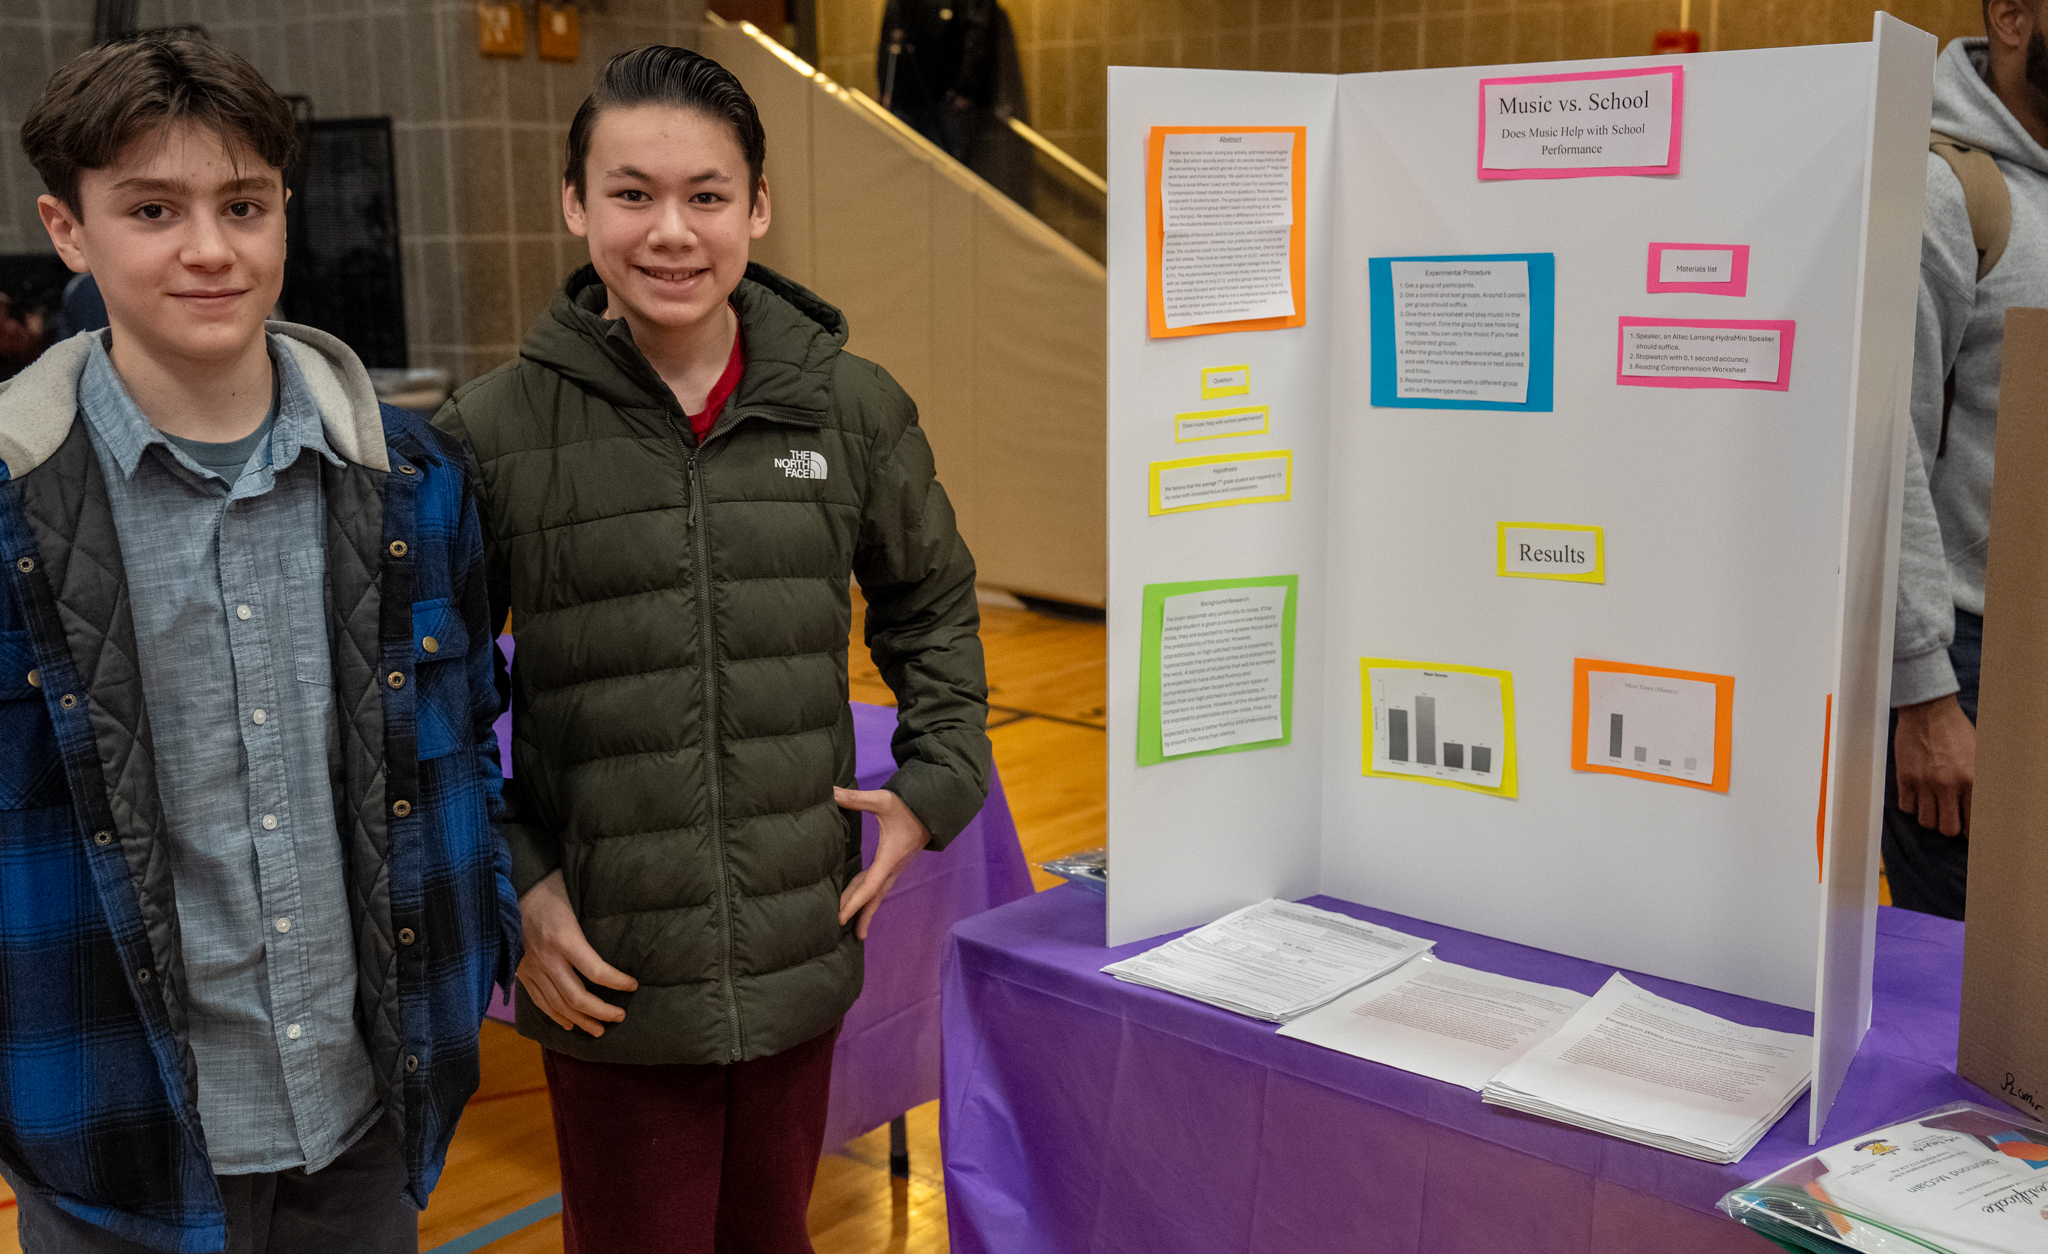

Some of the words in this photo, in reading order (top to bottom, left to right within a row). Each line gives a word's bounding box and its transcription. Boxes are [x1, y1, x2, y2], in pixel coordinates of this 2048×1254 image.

[1499, 95, 1552, 114] Music
[1559, 99, 1582, 112] vs.
[1588, 90, 1649, 111] School
[1502, 128, 1526, 139] Does
[1529, 126, 1558, 138] Music
[1561, 126, 1584, 138] Help
[1587, 125, 1608, 136] with
[1611, 123, 1645, 134] School
[1541, 145, 1602, 155] Performance
[1425, 270, 1462, 278] Experimental
[1636, 333, 1662, 341] Speaker,
[1690, 334, 1714, 342] Lansing
[1716, 334, 1747, 343] HydraMini
[1636, 354, 1668, 362] Stopwatch
[1661, 365, 1711, 374] Comprehension
[1238, 414, 1263, 423] performance?
[790, 450, 810, 460] THE
[774, 458, 810, 468] NORTH
[785, 468, 810, 478] FACE
[1519, 544, 1585, 563] Results
[1949, 1158, 1999, 1177] Desmond
[1907, 1172, 1951, 1193] McClain
[1982, 1181, 2048, 1213] ertificate
